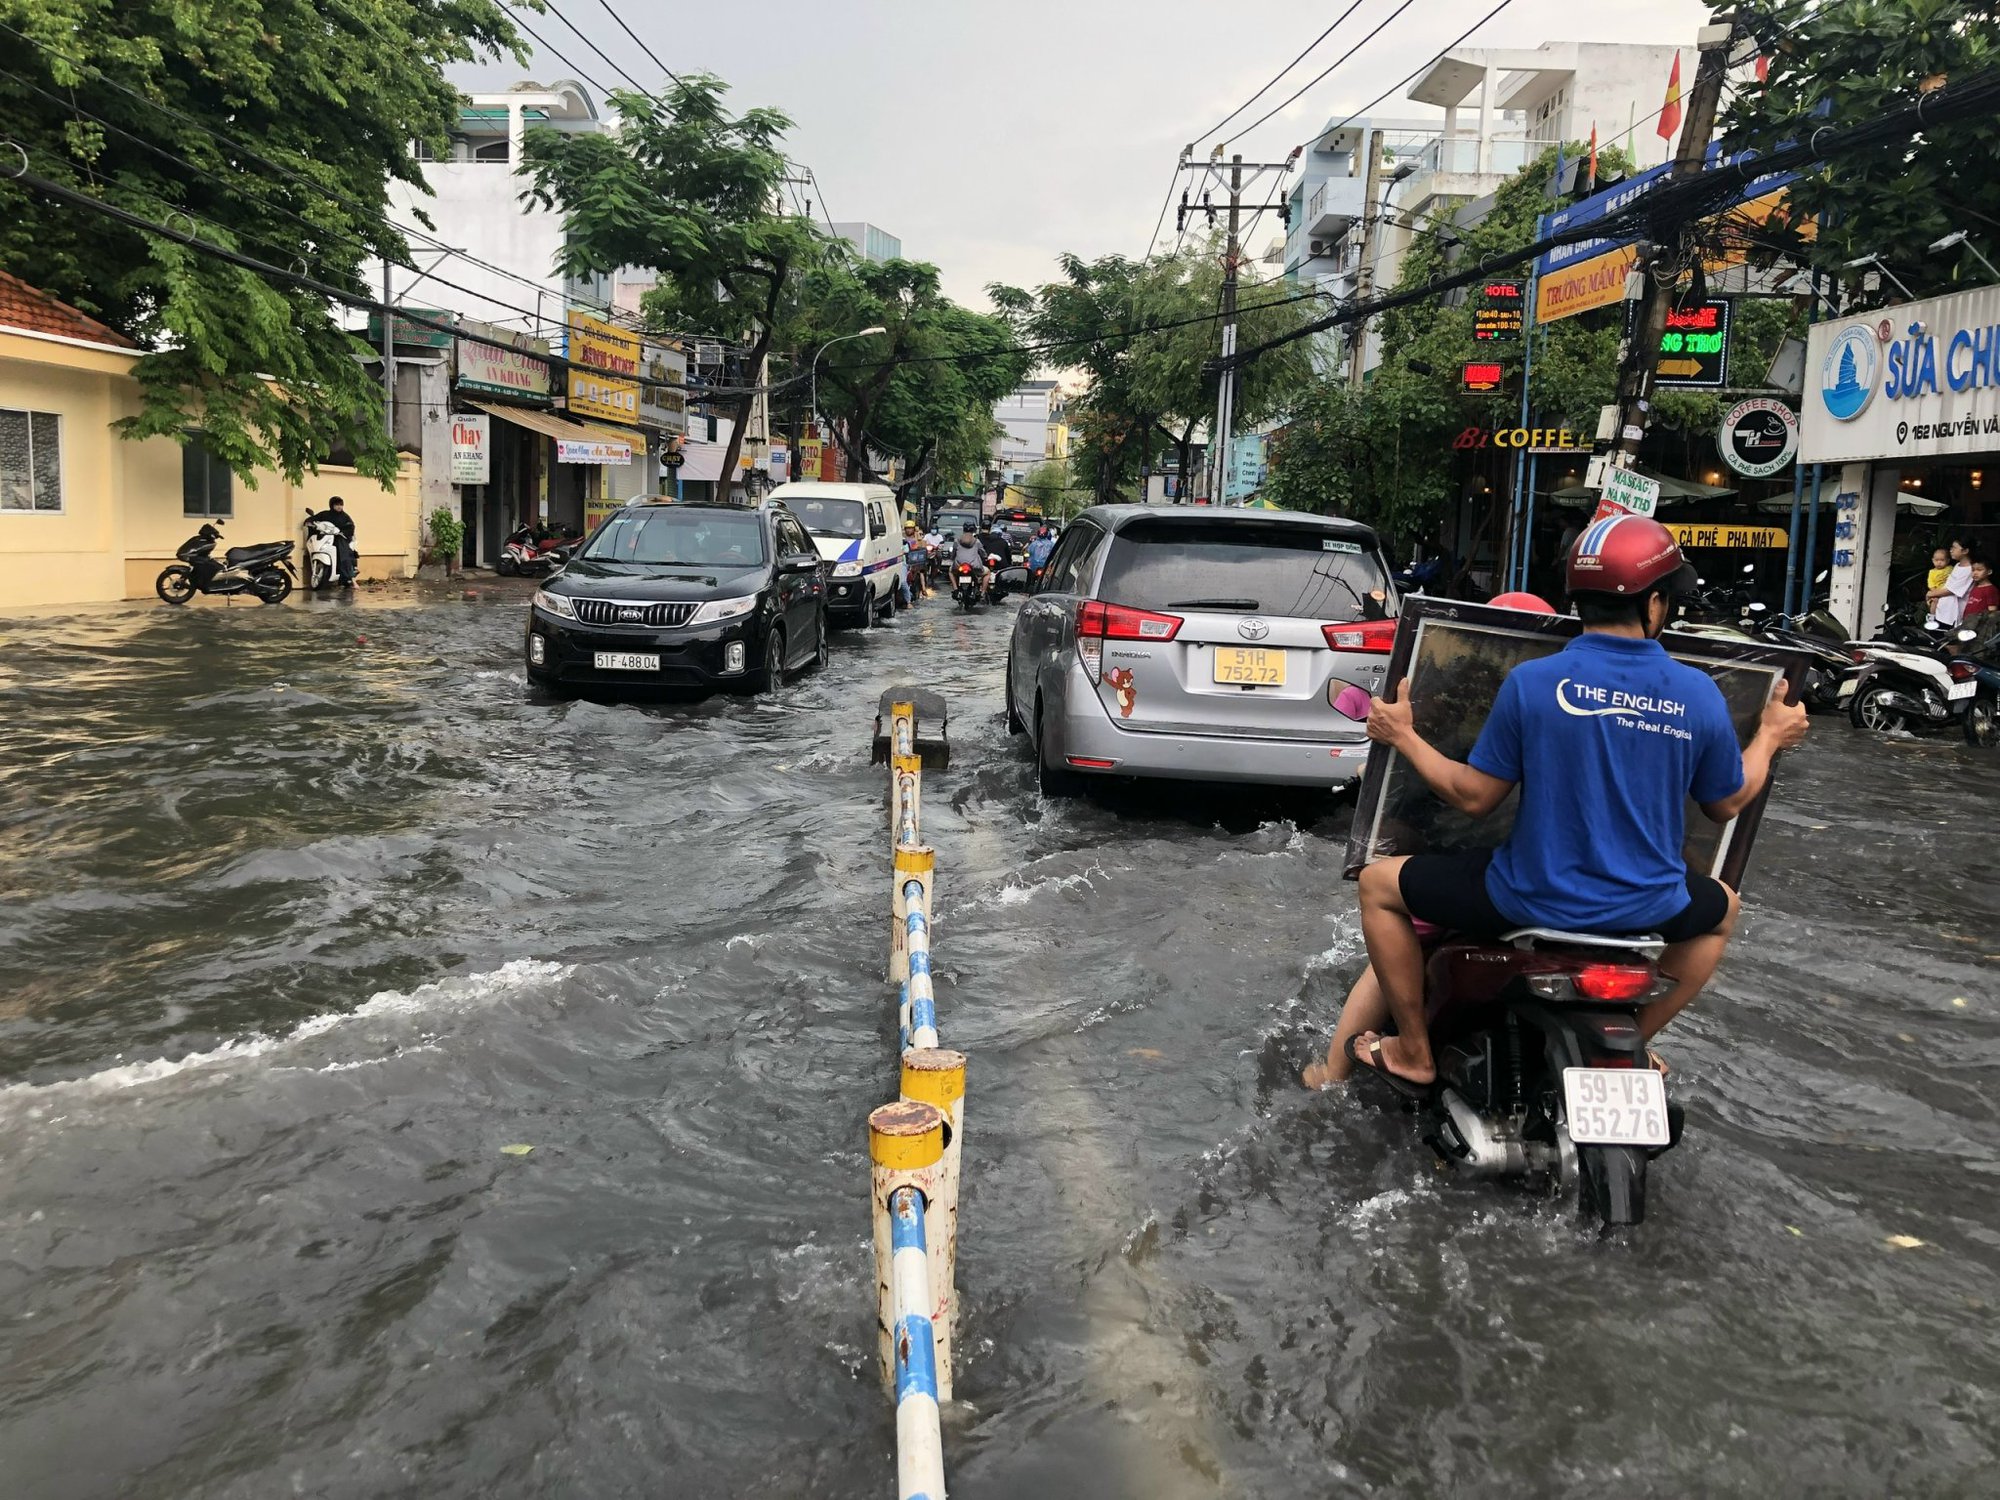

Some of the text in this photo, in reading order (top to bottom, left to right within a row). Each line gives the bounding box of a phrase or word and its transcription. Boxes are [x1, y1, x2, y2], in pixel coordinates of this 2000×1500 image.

[1726, 399, 1797, 427] COFFEE SHOP
[1912, 412, 2000, 440] 162 NGUYỄN VĂ
[1679, 526, 1775, 547] CÀ PHÊ PHA MÁY
[620, 611, 639, 619] KIA
[1236, 650, 1266, 666] 51H
[1223, 666, 1278, 682] 752.72
[1574, 684, 1686, 717] THE ENGLISH
[1616, 716, 1635, 728] The
[1637, 720, 1660, 733] Real
[1579, 1073, 1649, 1104] 59-V3
[1577, 1108, 1660, 1138] 552.76
